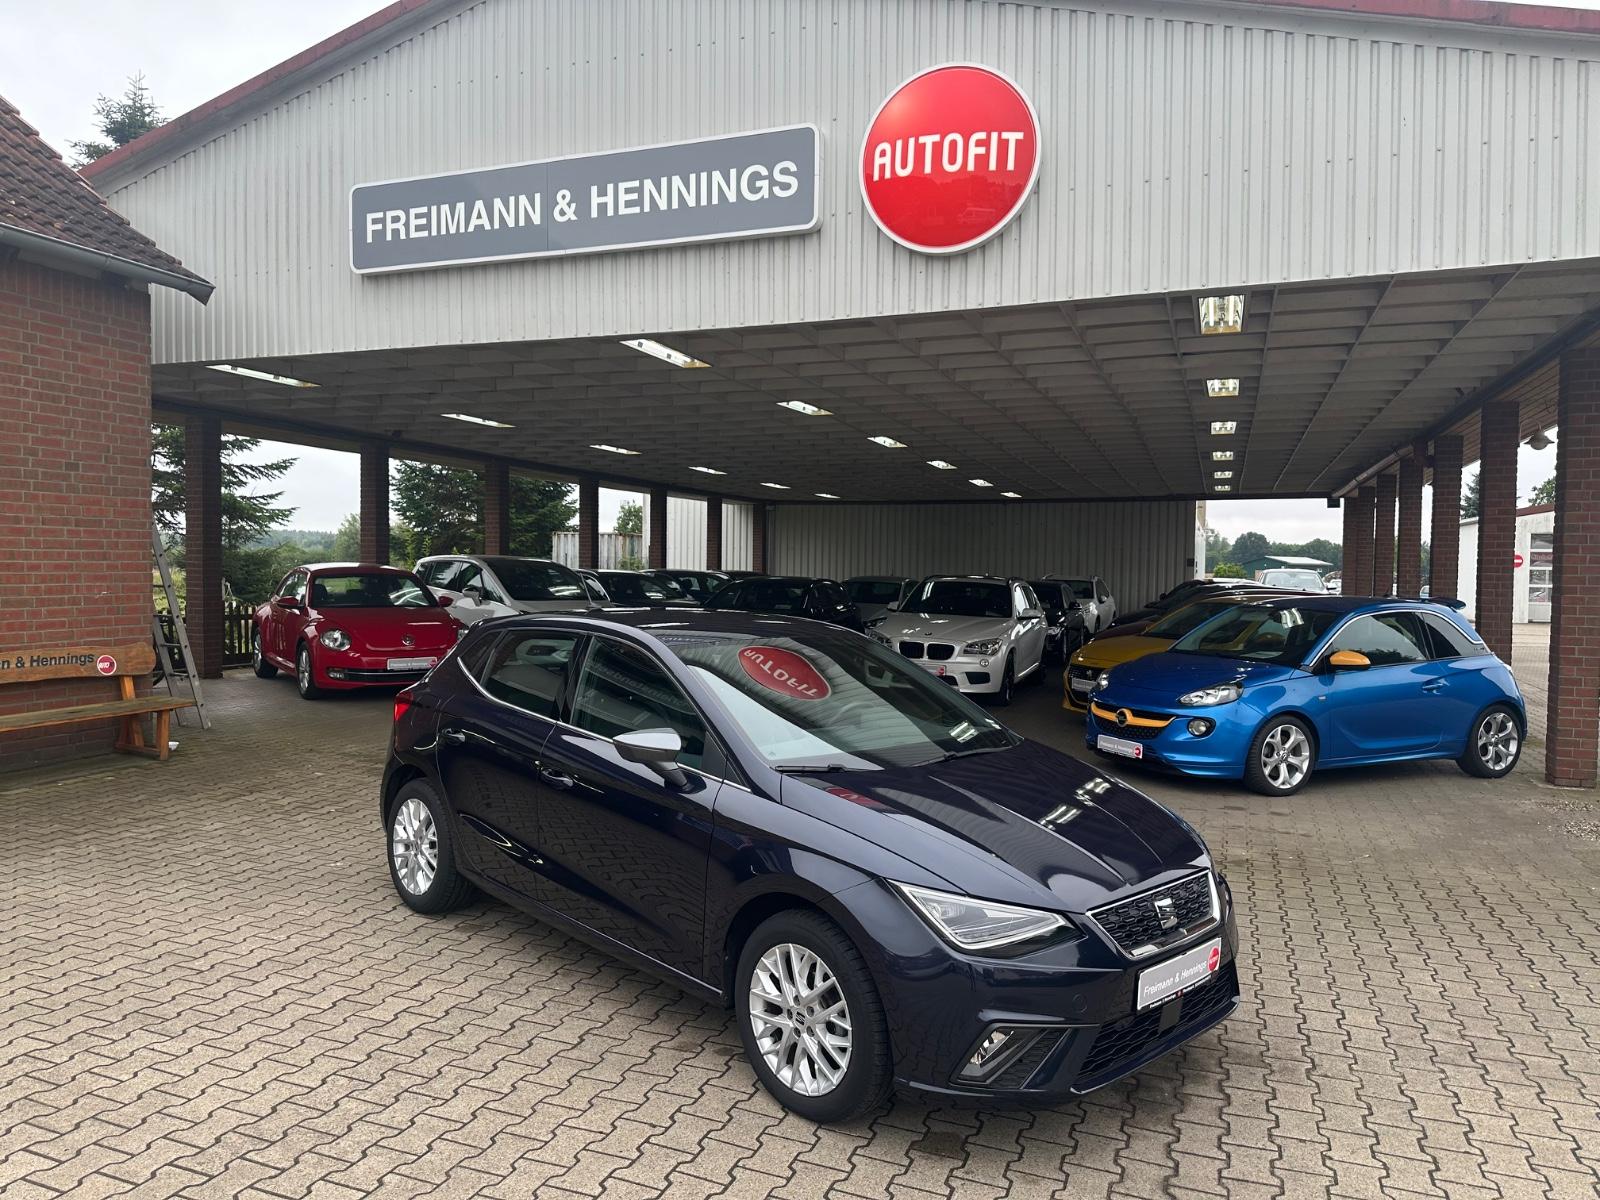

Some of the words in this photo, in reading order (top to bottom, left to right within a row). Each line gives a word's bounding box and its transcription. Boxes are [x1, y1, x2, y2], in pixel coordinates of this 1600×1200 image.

[873, 131, 1024, 182] AUTOFIT
[366, 193, 541, 243] FREIMANN
[553, 189, 578, 223] &
[590, 160, 799, 218] HENNINGS
[15, 655, 25, 668] &
[30, 652, 95, 668] Hennings
[1143, 976, 1174, 998] Freimann
[1180, 960, 1207, 980] Hennings
